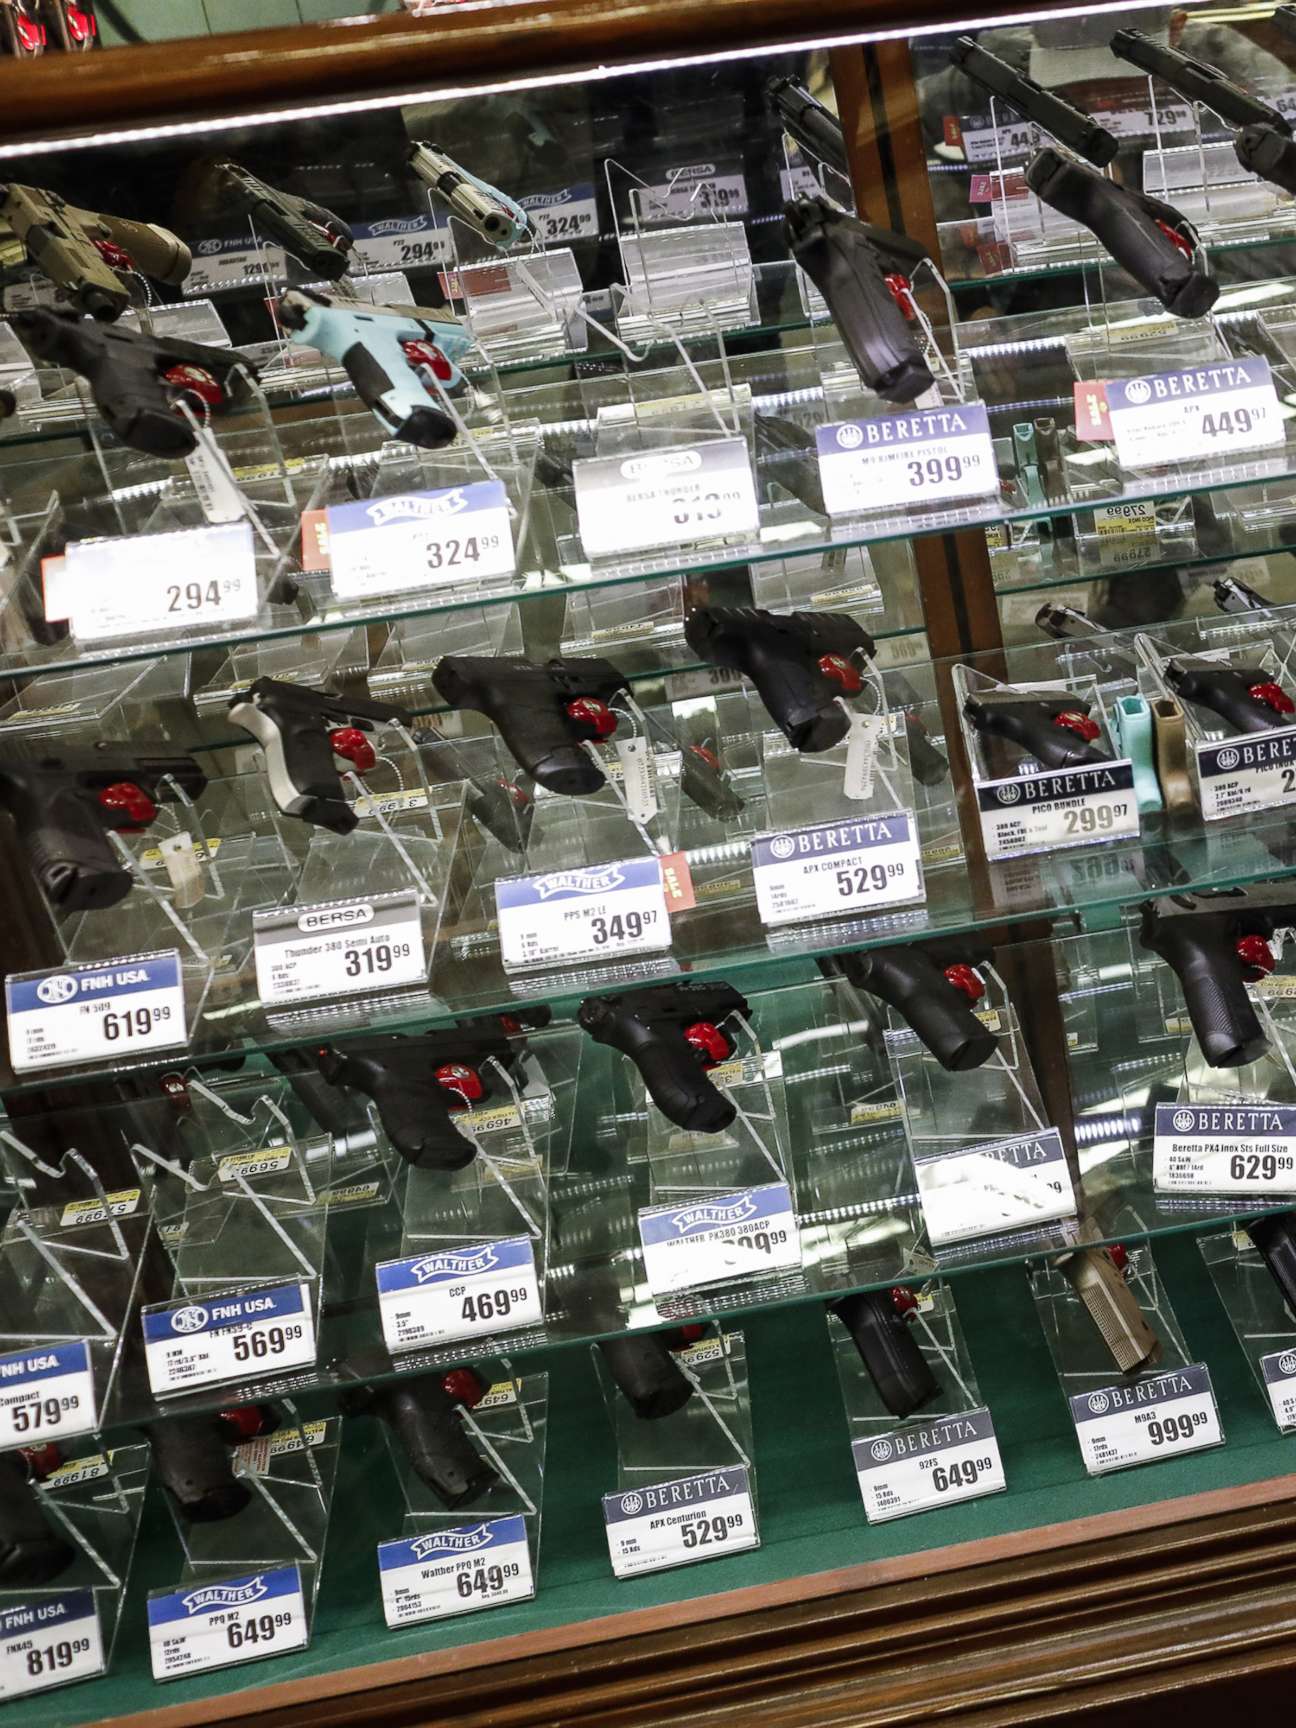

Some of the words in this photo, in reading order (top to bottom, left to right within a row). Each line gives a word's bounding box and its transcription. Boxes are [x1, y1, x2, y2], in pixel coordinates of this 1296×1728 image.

[1155, 367, 1251, 396] BERETTA
[866, 413, 967, 444] BERETTA
[1025, 777, 1117, 799] BERETTA
[1032, 802, 1052, 814] PICO
[1054, 798, 1086, 810] BUNDLE
[798, 823, 891, 852] BERETTA
[804, 861, 820, 874] APX
[822, 857, 862, 870] COMPACT
[546, 873, 610, 891] WALTHER
[663, 867, 683, 898] SALE
[307, 908, 368, 928] BERSA
[564, 910, 581, 921] PPS
[284, 944, 323, 958] Thunder
[344, 937, 367, 949] Semi
[370, 934, 390, 945] Auto
[81, 974, 115, 991] FNH
[1198, 1111, 1283, 1132] BERETTA
[1173, 1143, 1202, 1153] Beretta
[1204, 1143, 1220, 1153] PX4
[1221, 1143, 1238, 1153] Inox
[1240, 1144, 1253, 1153] Sts
[1255, 1143, 1270, 1153] Full
[1272, 1143, 1288, 1153] Size
[684, 1208, 743, 1226] WALTHER
[737, 1221, 770, 1236] 380ACP
[422, 1255, 487, 1273] WALTHER
[449, 1287, 466, 1298] CCP
[212, 1304, 242, 1321] FNH
[0, 1363, 24, 1377] NH
[1113, 1376, 1192, 1407] BERETTA
[1134, 1411, 1157, 1424] M9A3
[896, 1421, 977, 1454] BERETTA
[919, 1458, 939, 1469] 92FS
[646, 1476, 729, 1508] BERETTA
[650, 1519, 665, 1530] APX
[667, 1510, 707, 1527] Centurion
[421, 1532, 480, 1549] WALTHER
[421, 1565, 454, 1579] Walther
[455, 1560, 472, 1572] PPQ
[473, 1557, 485, 1567] M2
[193, 1587, 251, 1603] WALTHER
[6, 1611, 34, 1630] FNH
[209, 1615, 225, 1626] PPQ
[227, 1612, 240, 1621] M2
[6, 1640, 33, 1655] FNX45
